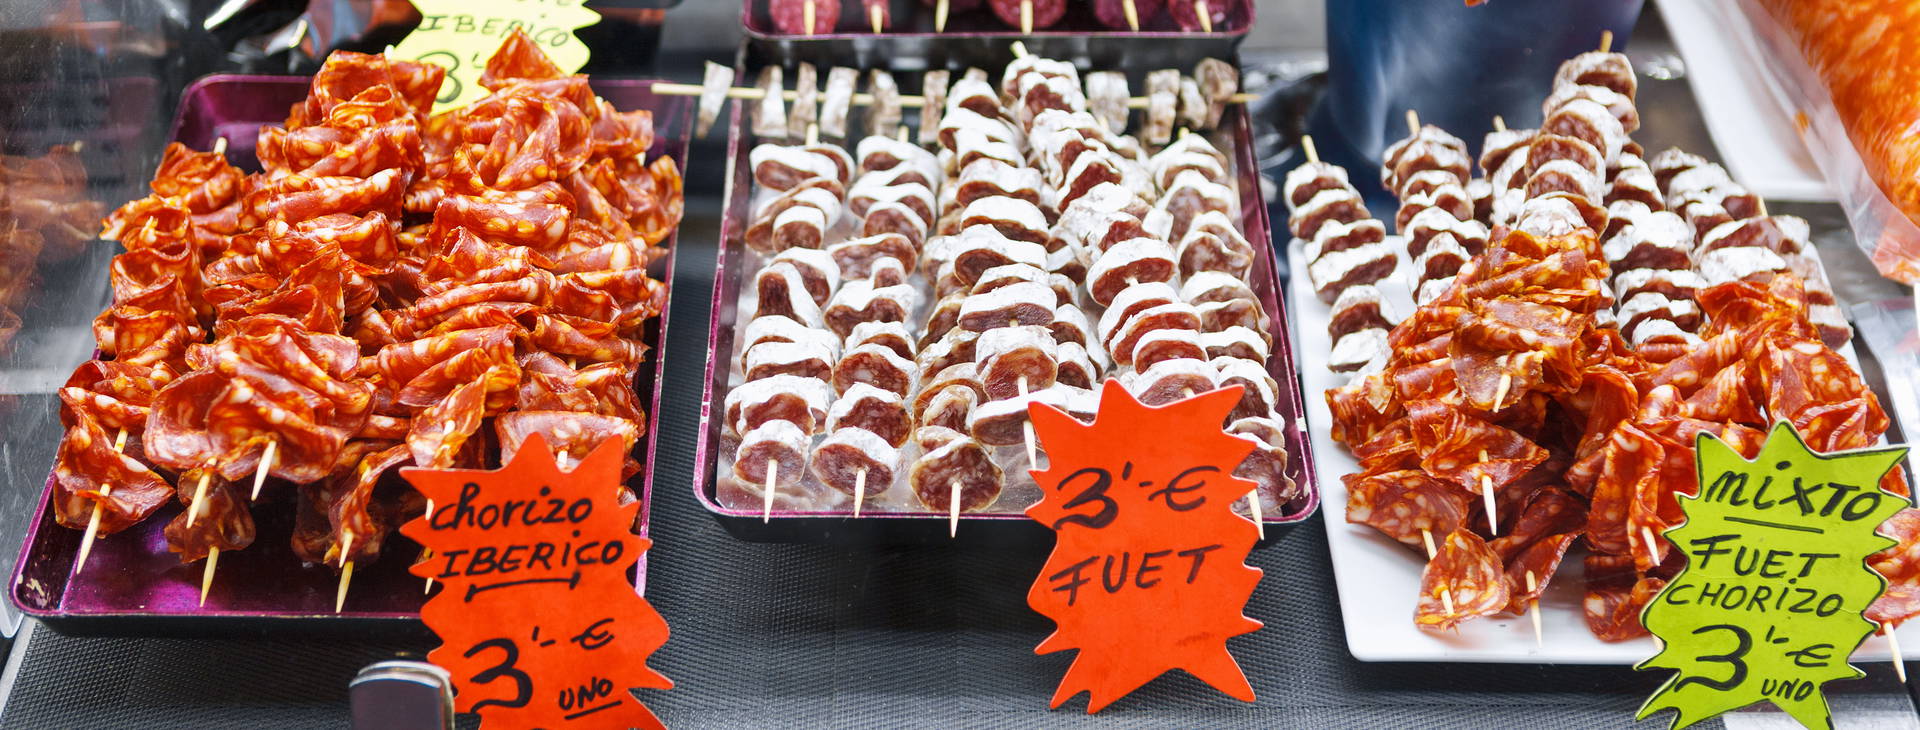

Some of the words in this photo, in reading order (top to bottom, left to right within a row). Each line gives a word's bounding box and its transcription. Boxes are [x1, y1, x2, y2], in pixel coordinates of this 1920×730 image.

[1690, 534, 1840, 577] FUET
[1049, 543, 1223, 607] FUET
[559, 676, 614, 710] UNO
[1760, 677, 1814, 701] UNO
